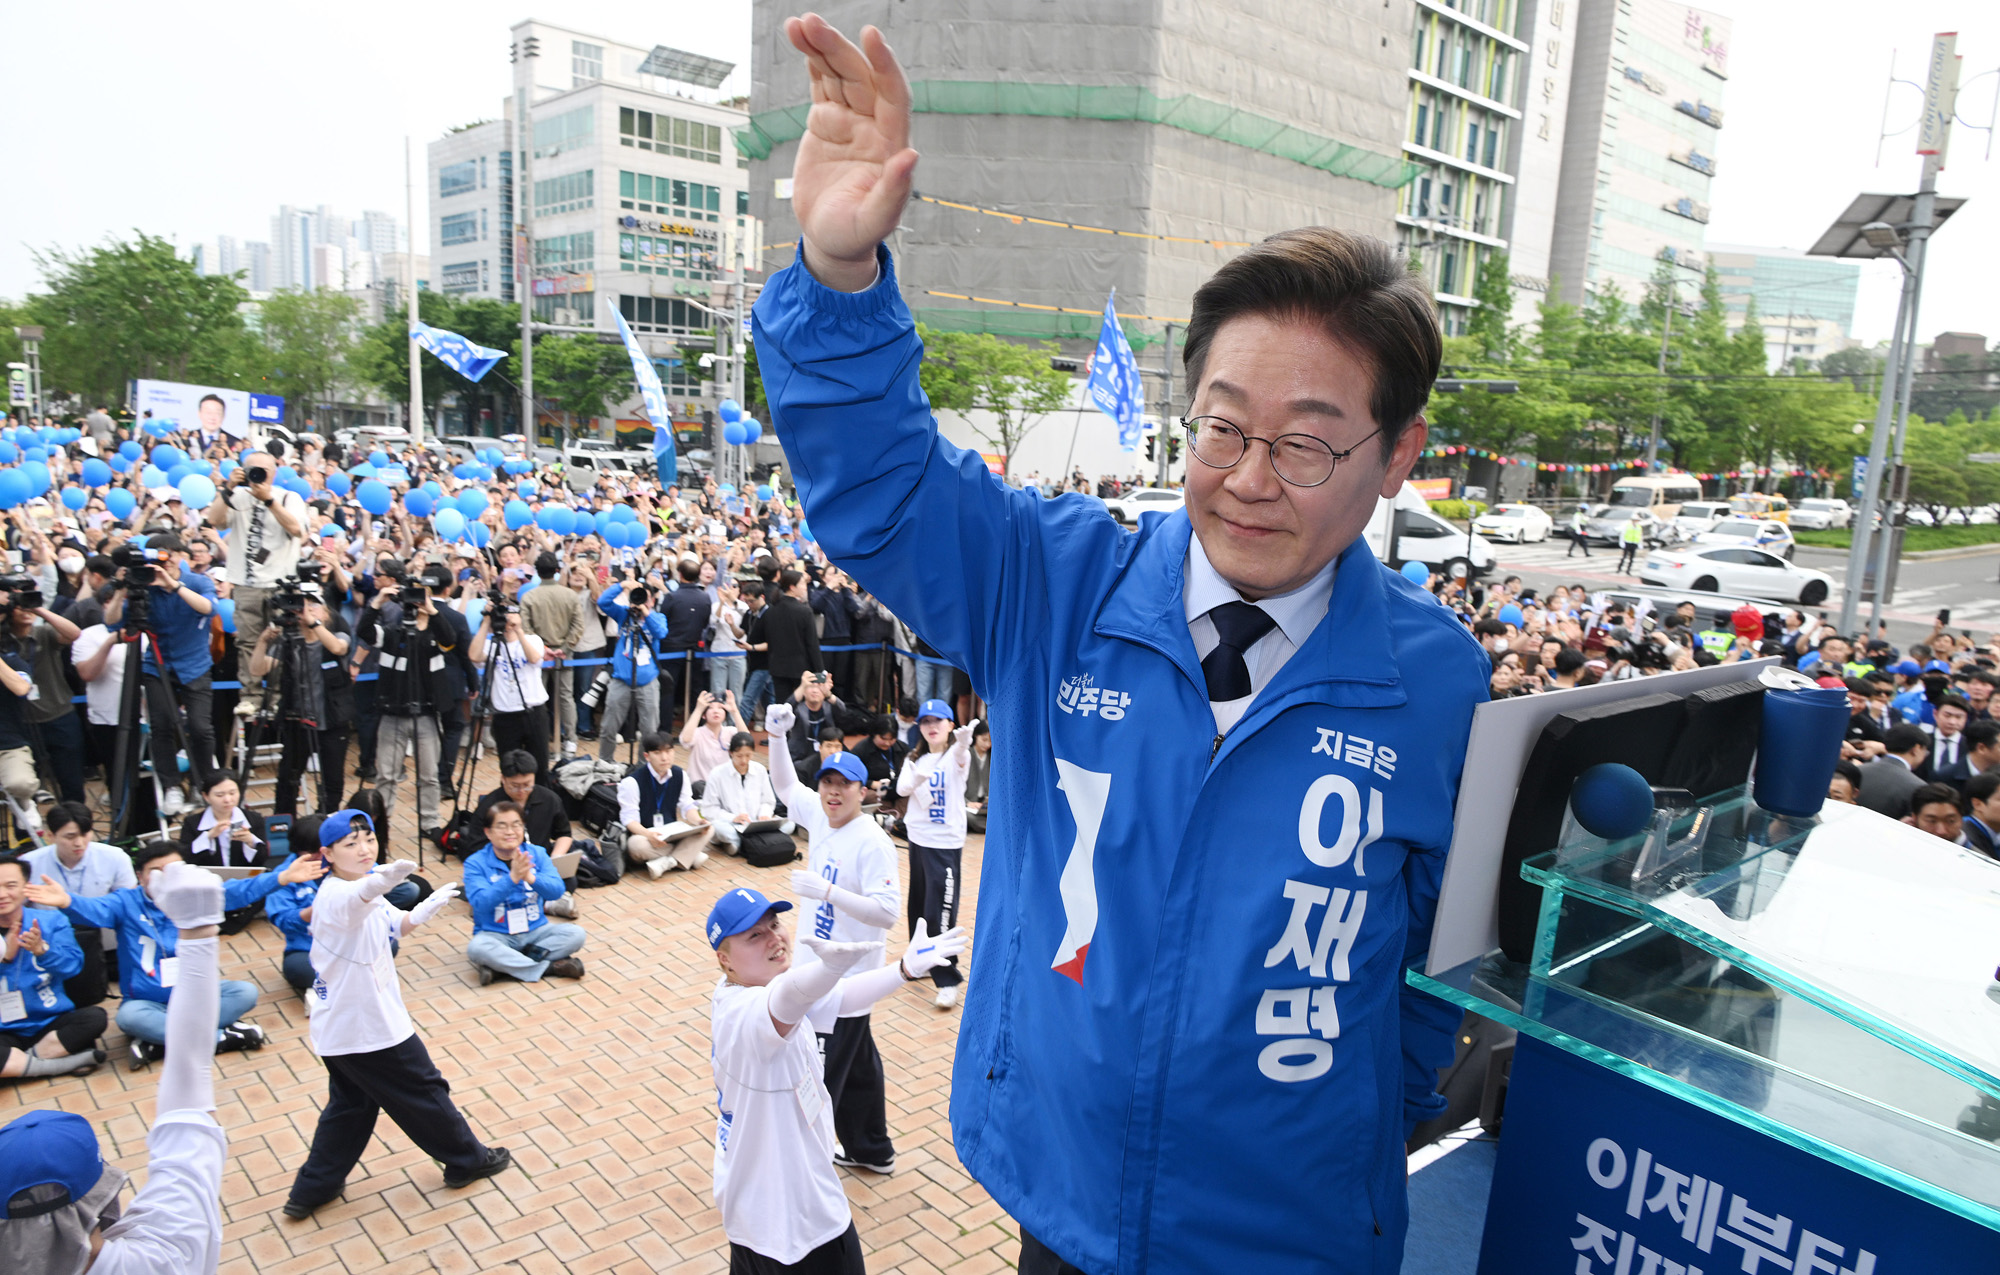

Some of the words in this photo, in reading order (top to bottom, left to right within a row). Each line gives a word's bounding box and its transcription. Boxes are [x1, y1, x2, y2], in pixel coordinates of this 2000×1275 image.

[1055, 678, 1132, 720] 민주당
[1071, 672, 1094, 688] 더불어
[1311, 727, 1398, 780] 지금은
[736, 889, 756, 903] 1
[1051, 758, 1112, 989] 1
[1255, 774, 1384, 1083] 이재명
[1586, 1137, 1878, 1275] 이제부터
